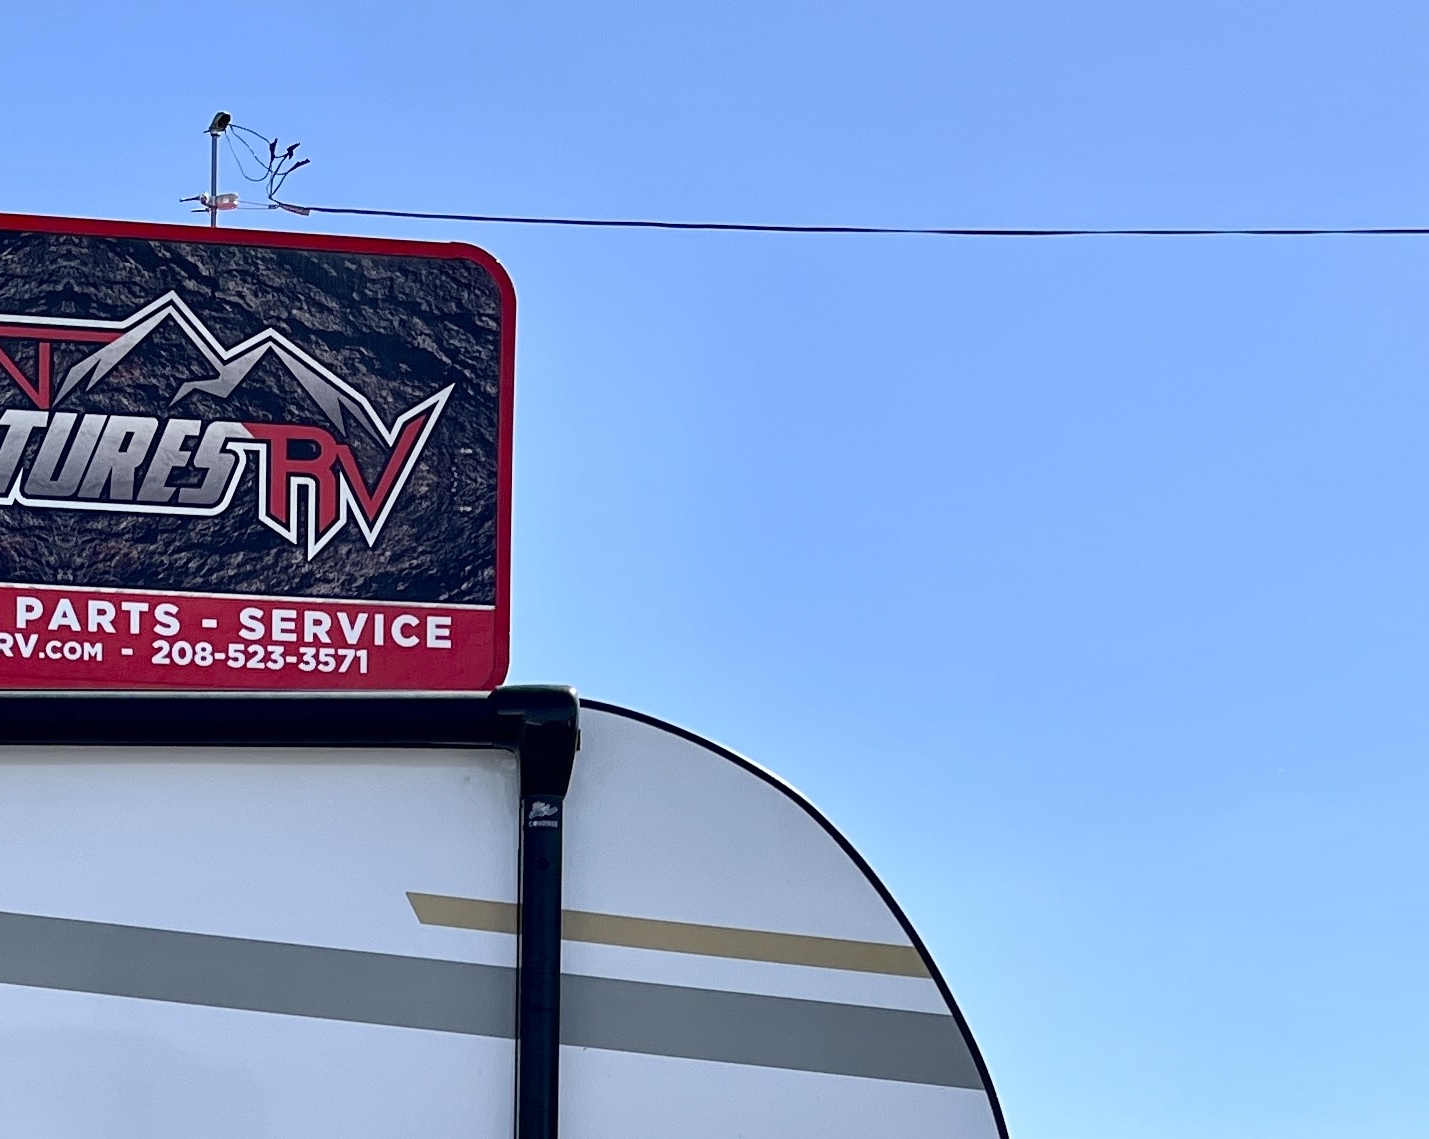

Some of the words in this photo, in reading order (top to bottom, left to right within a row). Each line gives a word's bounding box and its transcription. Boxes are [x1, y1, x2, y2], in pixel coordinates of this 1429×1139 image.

[242, 412, 428, 534] RV
[16, 596, 180, 637] PARTS
[238, 607, 452, 649] SERVICE
[151, 640, 368, 674] 208-523-3571
